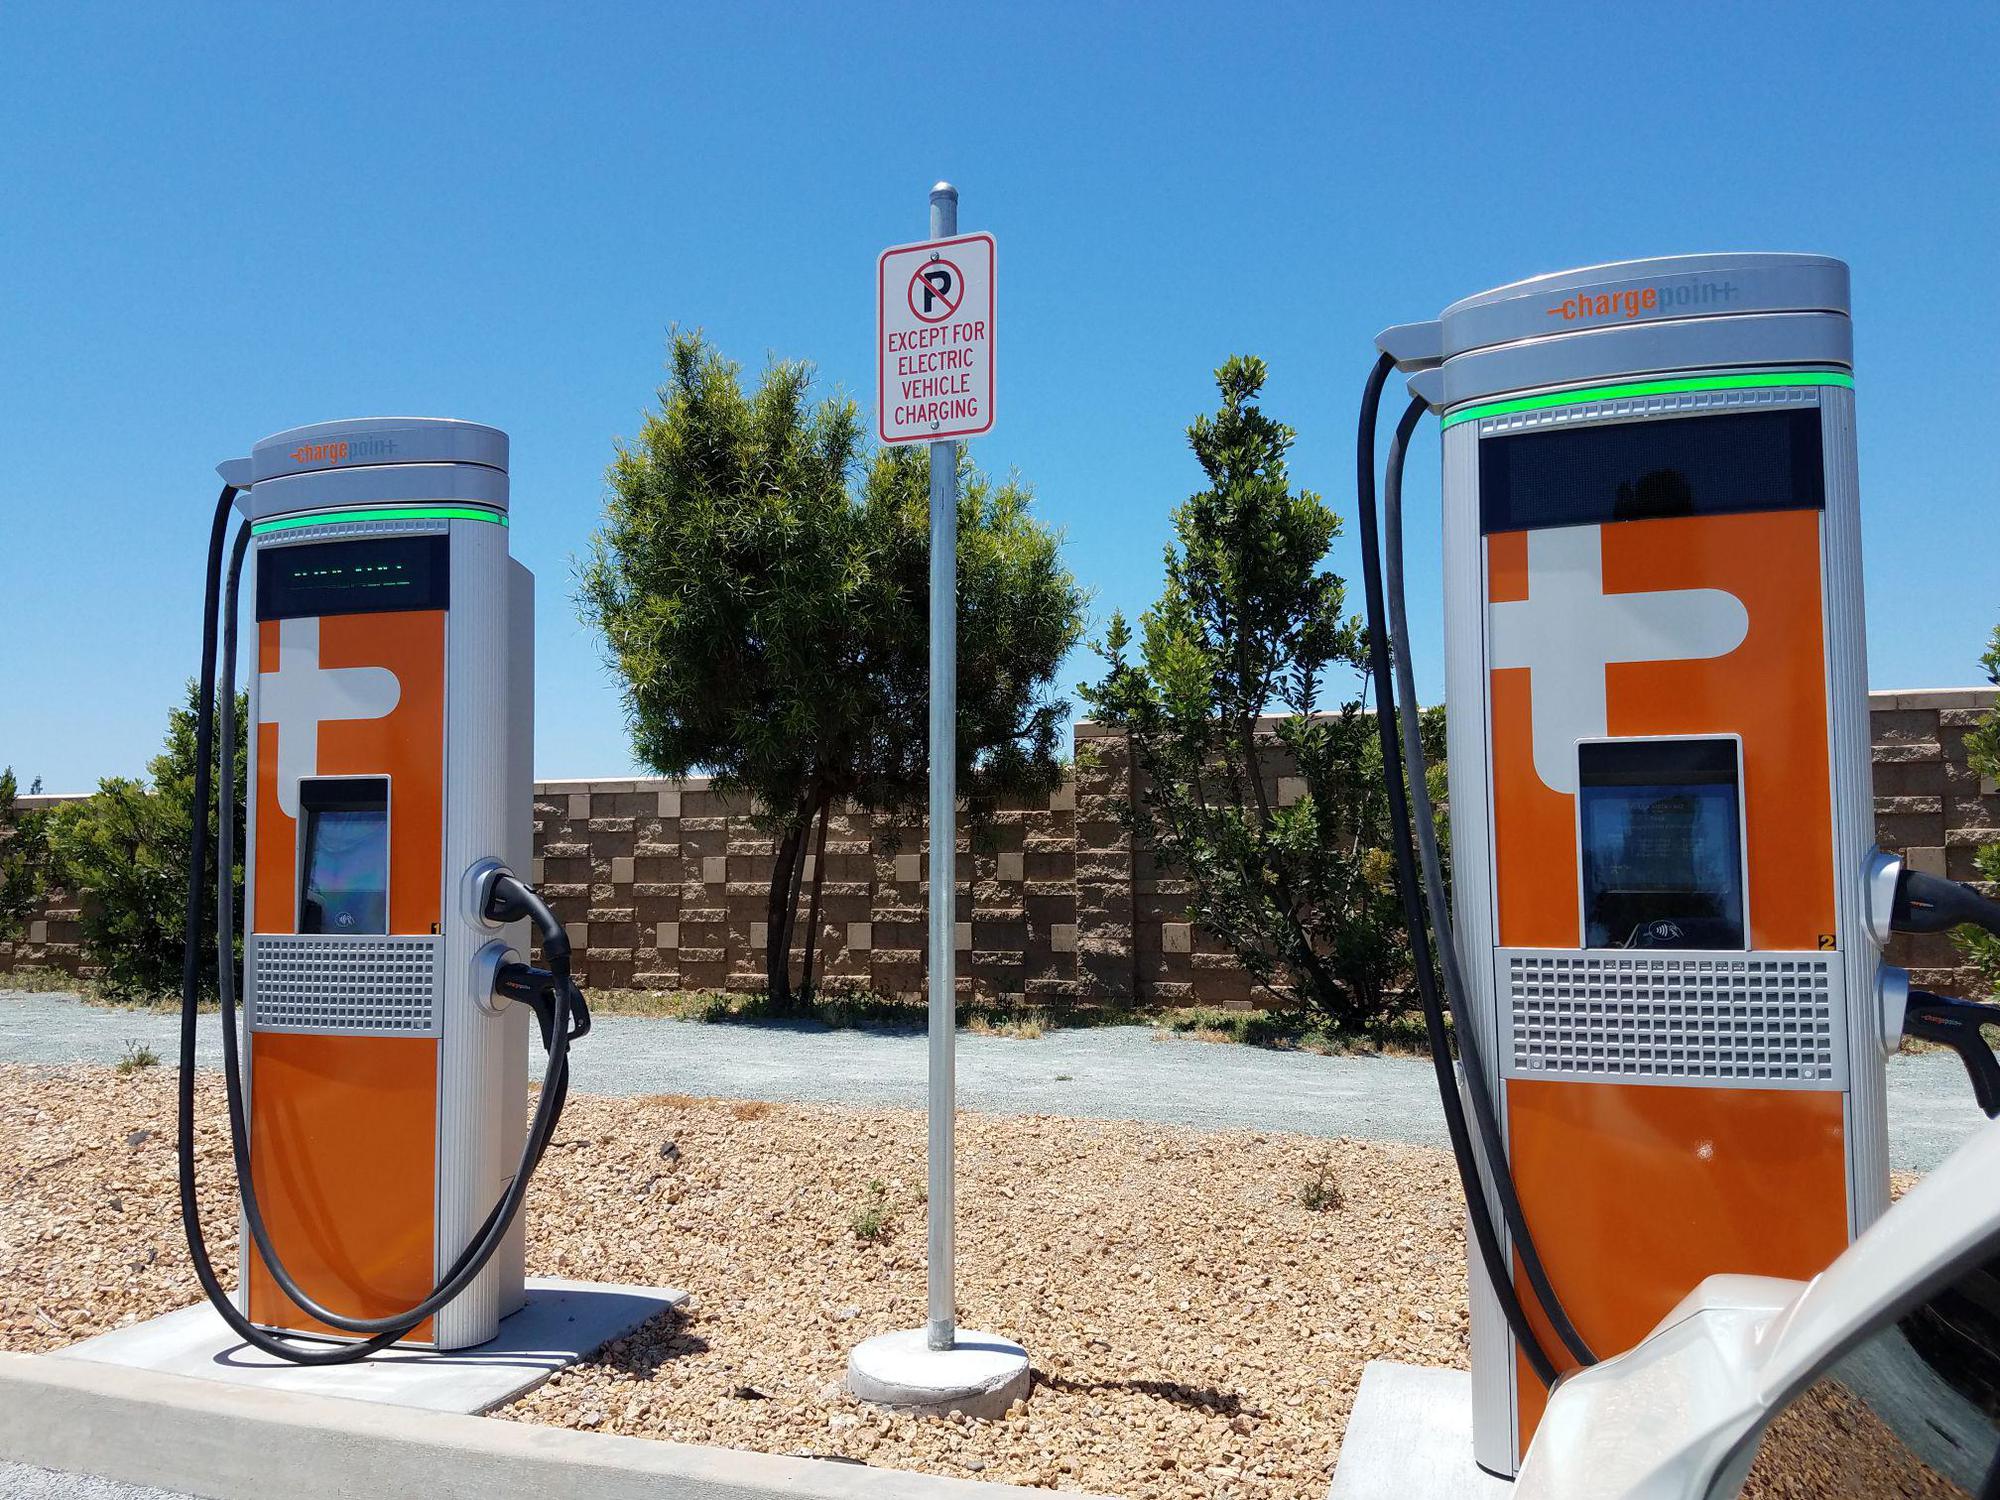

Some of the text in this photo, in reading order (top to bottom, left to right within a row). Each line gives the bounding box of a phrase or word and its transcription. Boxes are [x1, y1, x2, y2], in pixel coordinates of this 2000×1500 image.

[888, 321, 985, 352] EXCEPT FOR
[898, 348, 974, 376] ELECTRIC
[902, 373, 971, 400] VEHICLE
[894, 397, 978, 425] CHARGING
[1820, 935, 1835, 950] 2
